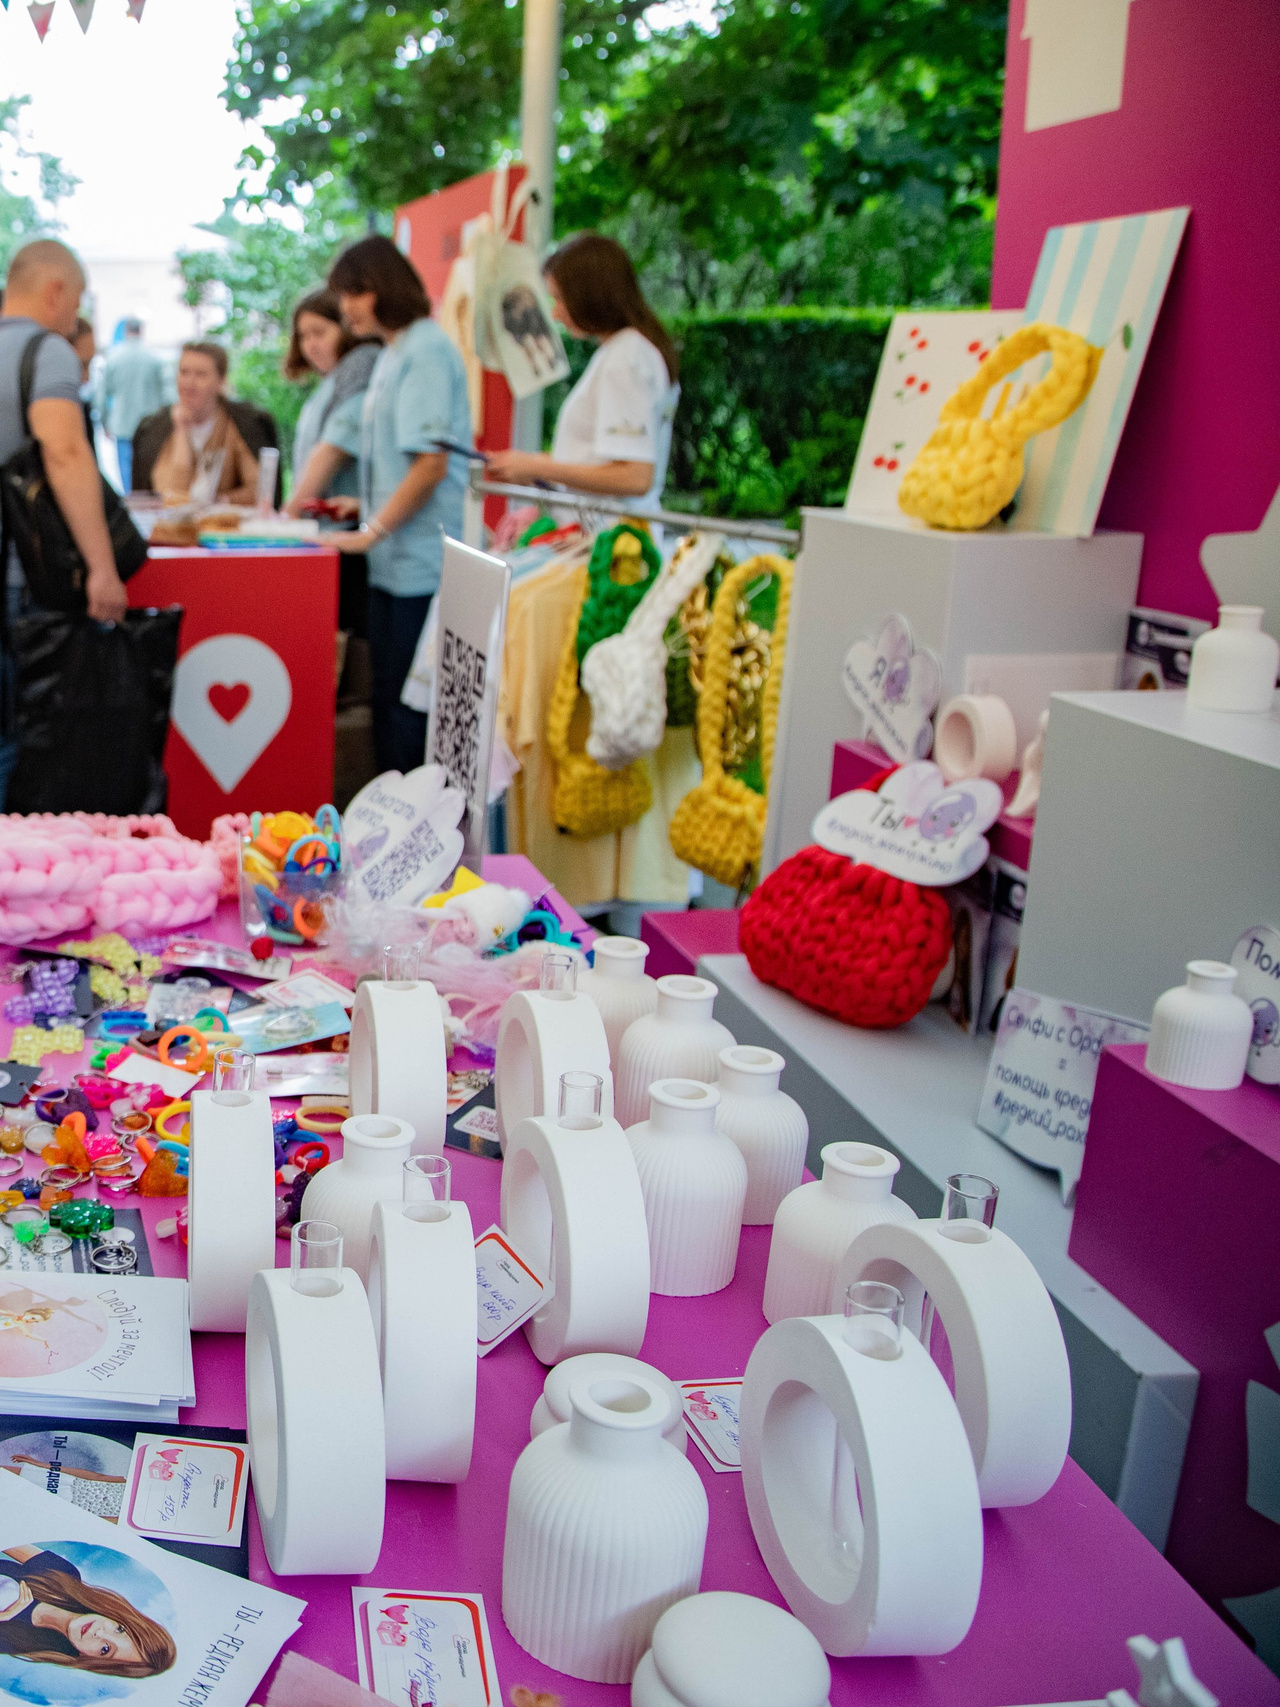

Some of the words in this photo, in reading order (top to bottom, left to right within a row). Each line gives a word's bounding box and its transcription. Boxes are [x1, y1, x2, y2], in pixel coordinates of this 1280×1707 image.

[871, 798, 905, 832] Ты
[1007, 1004, 1055, 1039] Селфи
[995, 1064, 1050, 1099] помощь
[97, 1289, 142, 1325] Следуй
[122, 1328, 140, 1340] за
[234, 1604, 263, 1625] ТЫ
[196, 1633, 244, 1682] РЕДКАЯ
